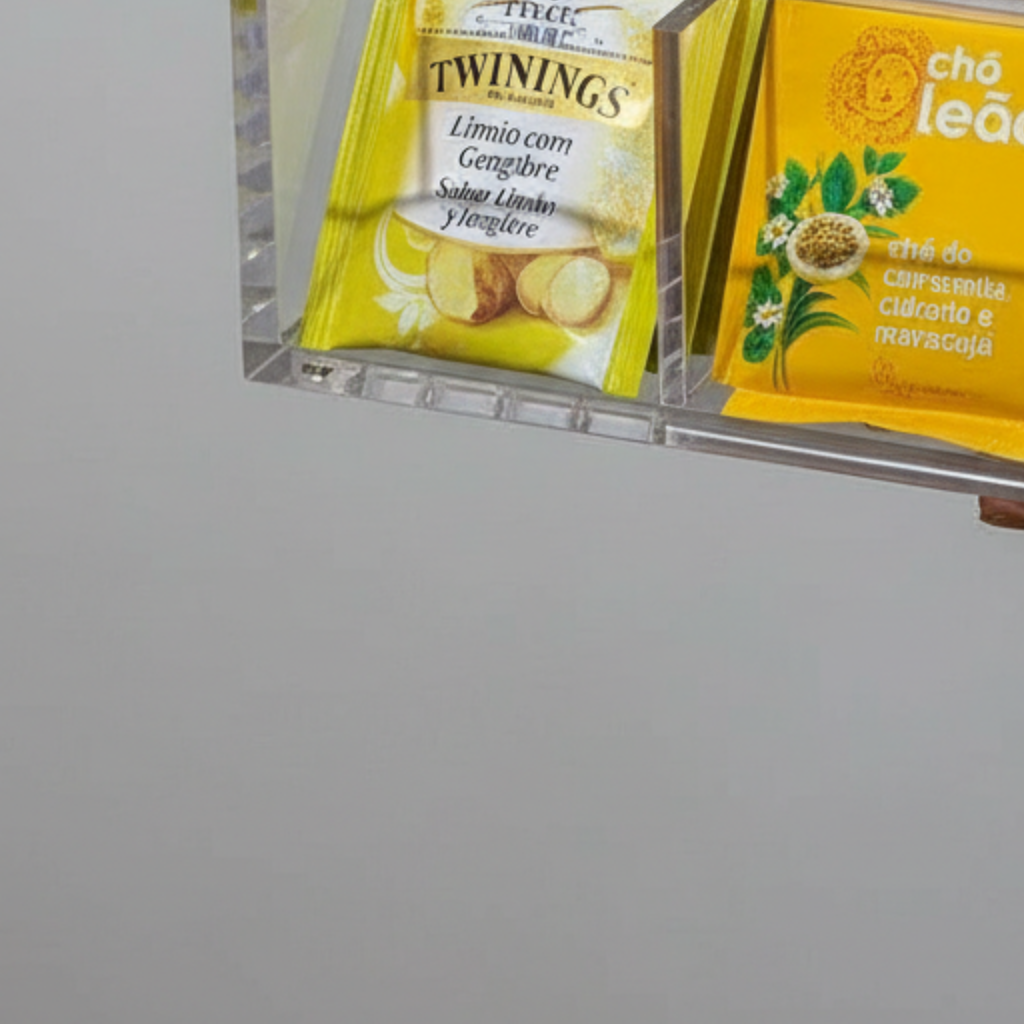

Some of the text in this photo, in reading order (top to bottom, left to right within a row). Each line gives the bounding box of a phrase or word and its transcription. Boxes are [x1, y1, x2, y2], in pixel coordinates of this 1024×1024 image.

[429, 51, 630, 119] TWININGS
[942, 239, 973, 265] do
[977, 308, 996, 328] e
